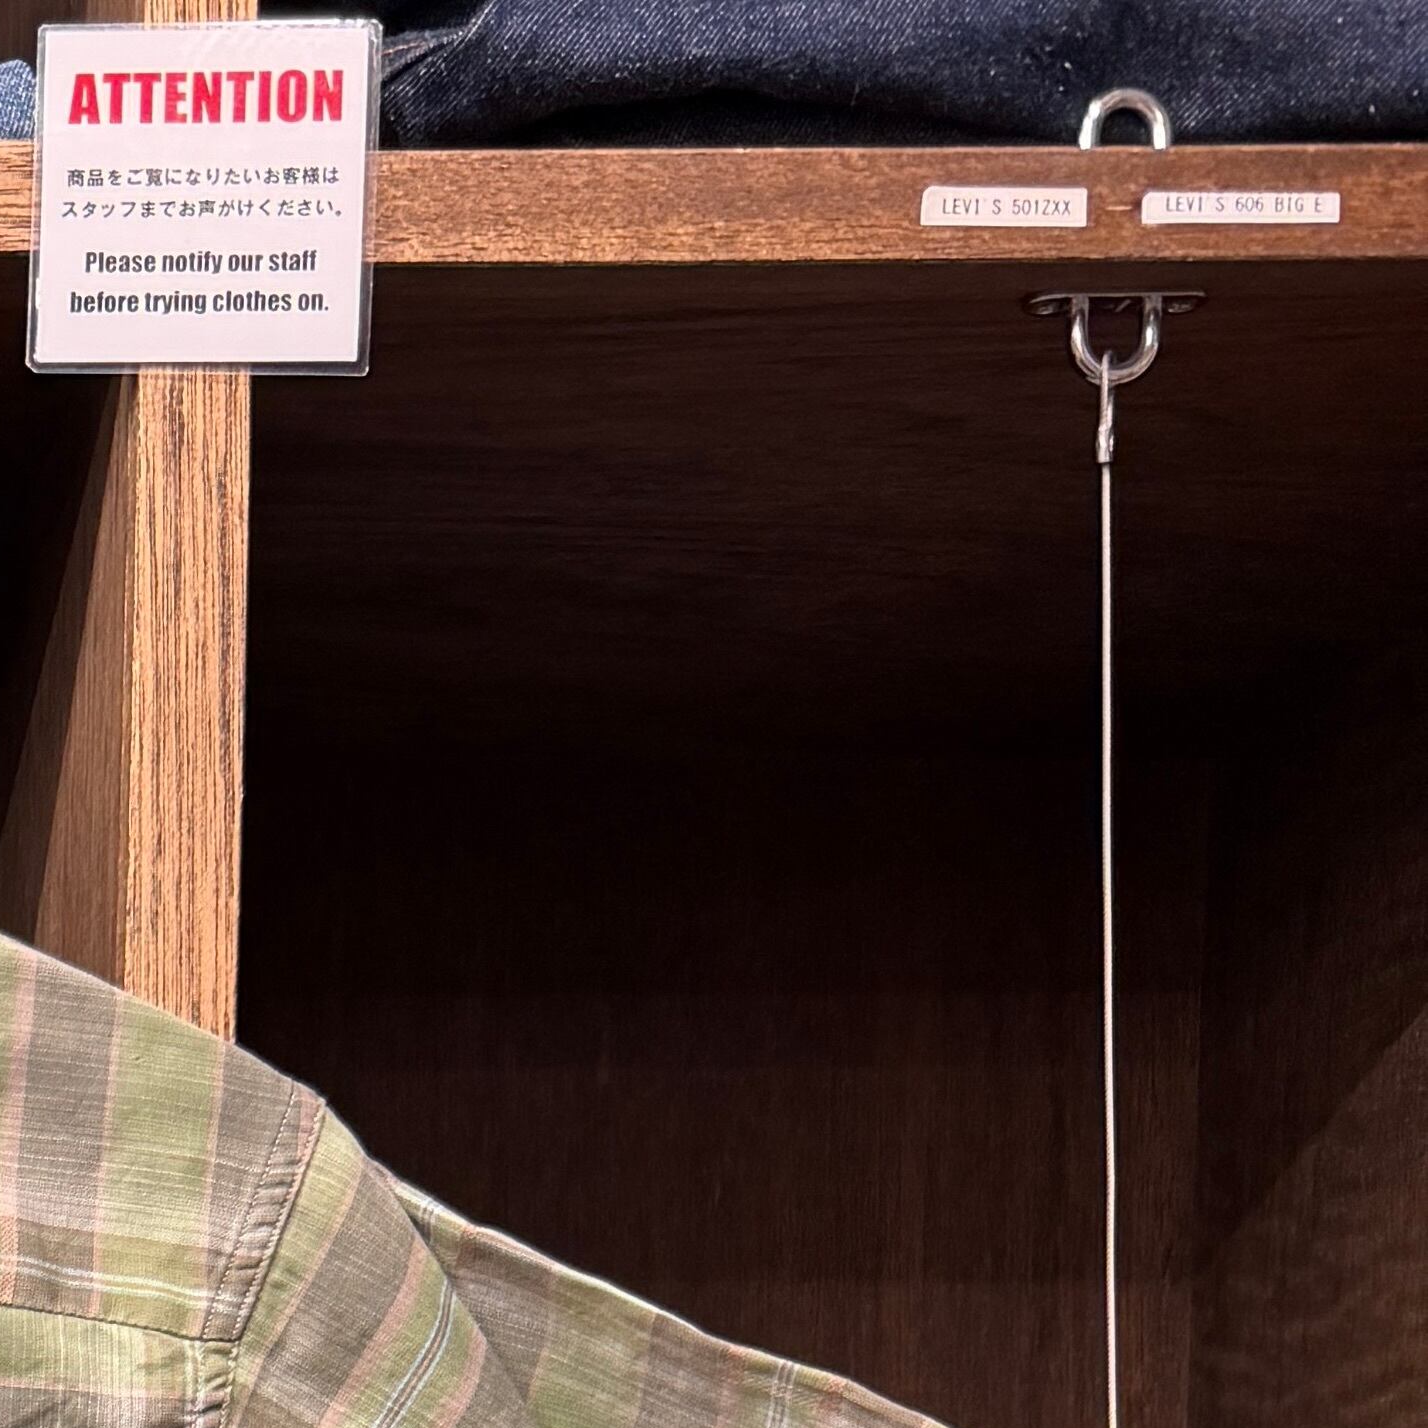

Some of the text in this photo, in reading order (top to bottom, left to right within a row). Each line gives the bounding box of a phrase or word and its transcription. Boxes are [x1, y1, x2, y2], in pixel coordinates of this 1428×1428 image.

[69, 70, 343, 124] ATTENTION
[68, 167, 339, 187] 商品をご覧になりたいお客様は
[62, 199, 341, 218] スタッフまでお声がけください。
[1236, 193, 1263, 212] 606
[1275, 193, 1303, 212] BIG
[1315, 193, 1323, 212] E
[86, 250, 316, 274] Please notify our staff
[71, 291, 328, 314] before trying clothes on.
